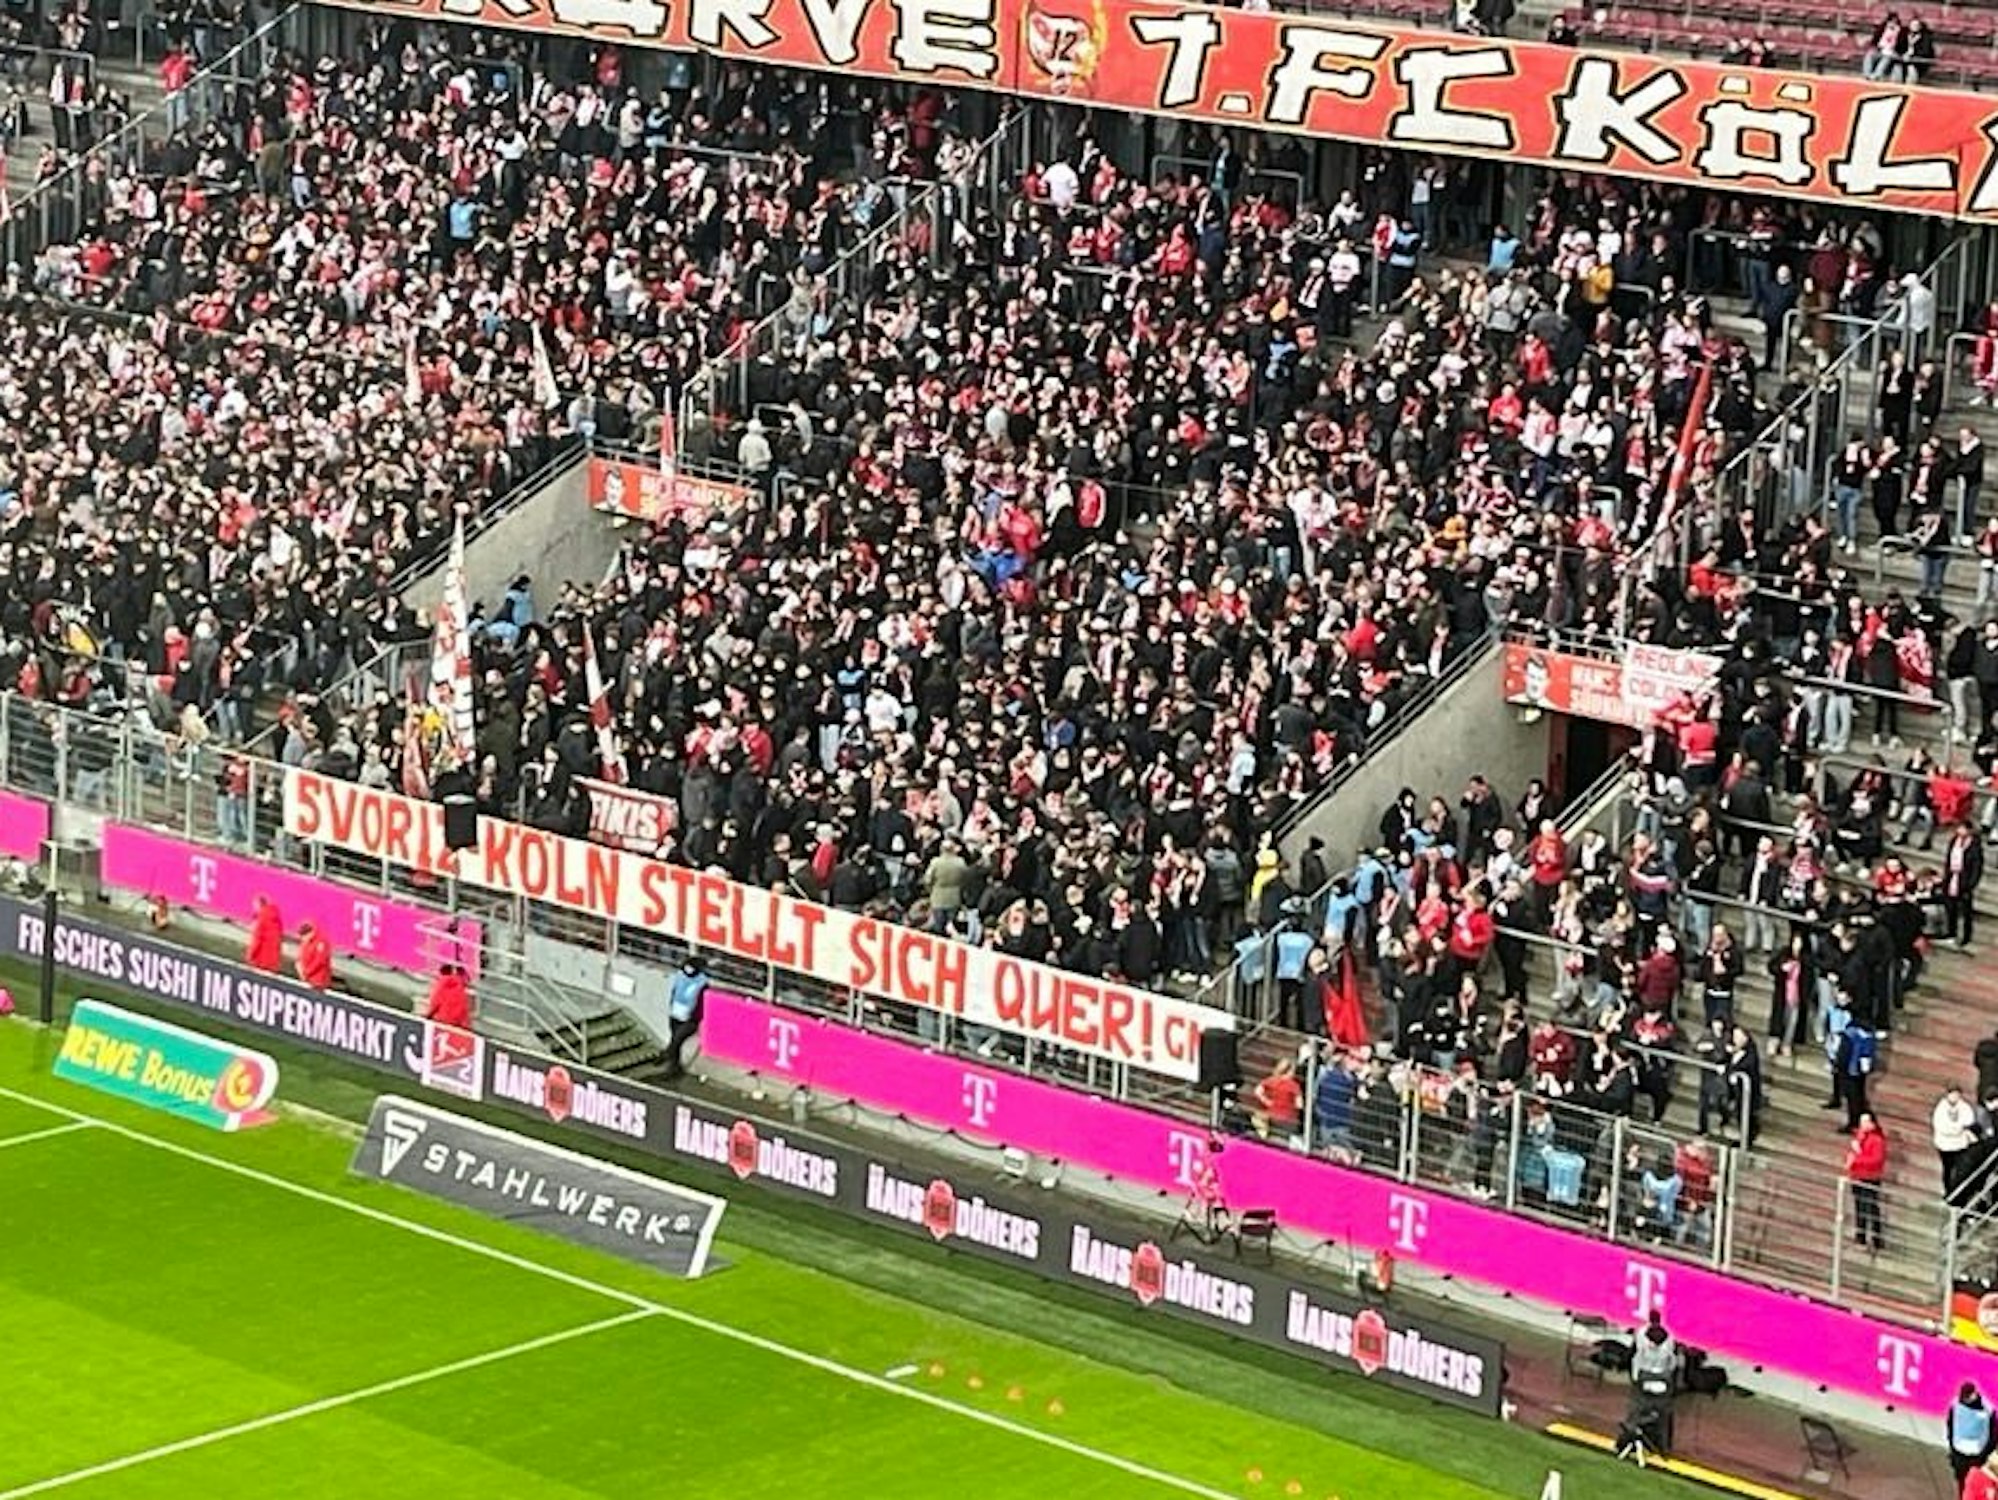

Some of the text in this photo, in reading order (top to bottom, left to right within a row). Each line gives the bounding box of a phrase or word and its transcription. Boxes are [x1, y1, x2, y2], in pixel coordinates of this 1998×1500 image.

[1048, 29, 1078, 61] 12
[1555, 58, 1998, 213] KÖL
[17, 913, 398, 1062] FRSCHES SUSHI IM SUPERMARKT
[640, 863, 826, 971] STELLT
[849, 920, 969, 1014] SICH
[991, 958, 1154, 1063] QUER!
[62, 1023, 142, 1079] REWE
[571, 1081, 646, 1138] DÖNERS
[758, 1137, 838, 1197] DÖNERS
[955, 1196, 1040, 1259] DÖNERS
[1164, 1260, 1254, 1325] DÖNERS
[1387, 1328, 1484, 1398] DÖNERS
